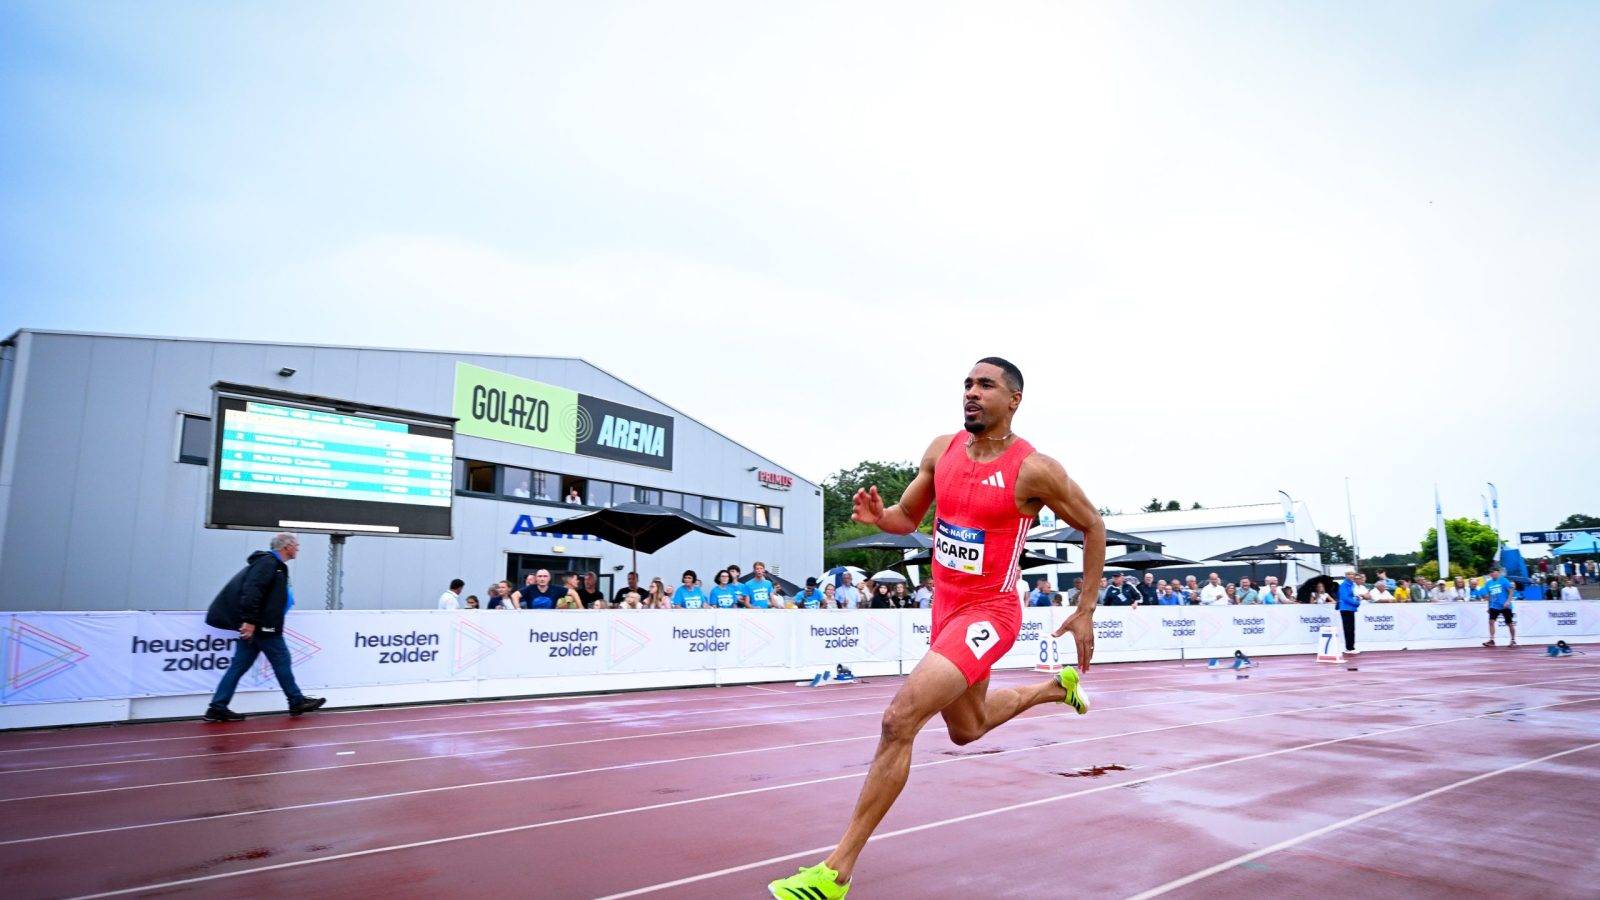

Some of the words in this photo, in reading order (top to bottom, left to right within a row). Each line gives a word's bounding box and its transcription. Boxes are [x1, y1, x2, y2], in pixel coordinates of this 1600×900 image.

[472, 384, 549, 433] GOLAZO
[597, 415, 665, 457] ARENA
[758, 471, 792, 488] PRIMUS
[936, 538, 979, 561] AGARD
[1021, 620, 1042, 631] sden
[1092, 619, 1123, 629] eusden
[1162, 618, 1196, 628] heusden
[1233, 616, 1265, 626] heusden
[1300, 614, 1331, 624] heusden
[529, 628, 598, 643] heusden
[672, 626, 730, 640] heusden
[810, 624, 859, 638] heusden
[1098, 628, 1123, 639] zolder
[1173, 628, 1196, 637] zolder
[1242, 626, 1265, 635] zolder
[132, 635, 238, 654] heusden
[354, 630, 439, 648] heusden
[689, 638, 730, 653] zolder
[825, 636, 859, 649] zolder
[971, 629, 990, 648] 2
[1321, 633, 1333, 655] 7
[378, 647, 439, 664] zolder
[549, 641, 598, 657] zolder
[1039, 640, 1048, 663] 8
[1052, 640, 1060, 663] 8
[162, 653, 232, 672] zolde
